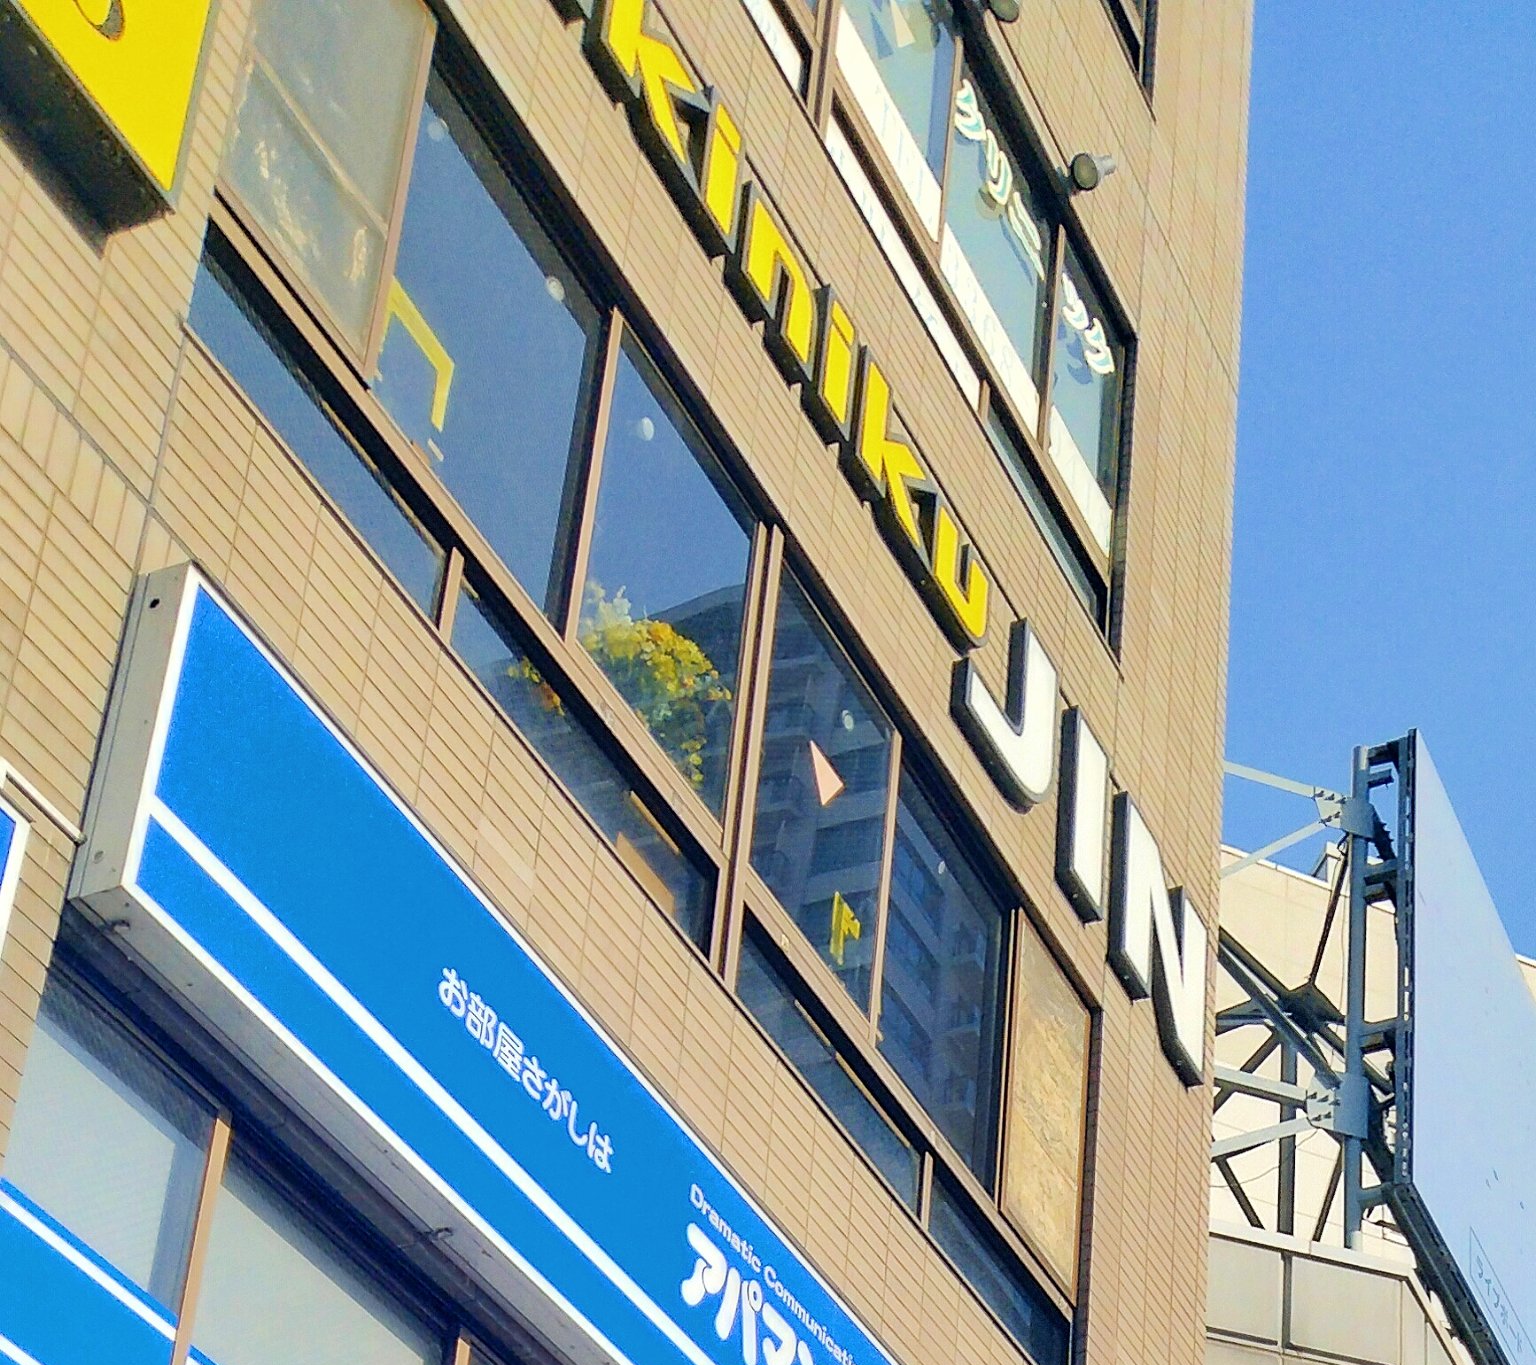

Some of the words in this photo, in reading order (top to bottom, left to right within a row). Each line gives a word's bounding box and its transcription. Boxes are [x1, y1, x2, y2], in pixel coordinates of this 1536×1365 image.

[951, 619, 1207, 1088] JIN
[437, 966, 616, 1174] お部屋さがしは
[687, 1182, 763, 1272] Dramatic
